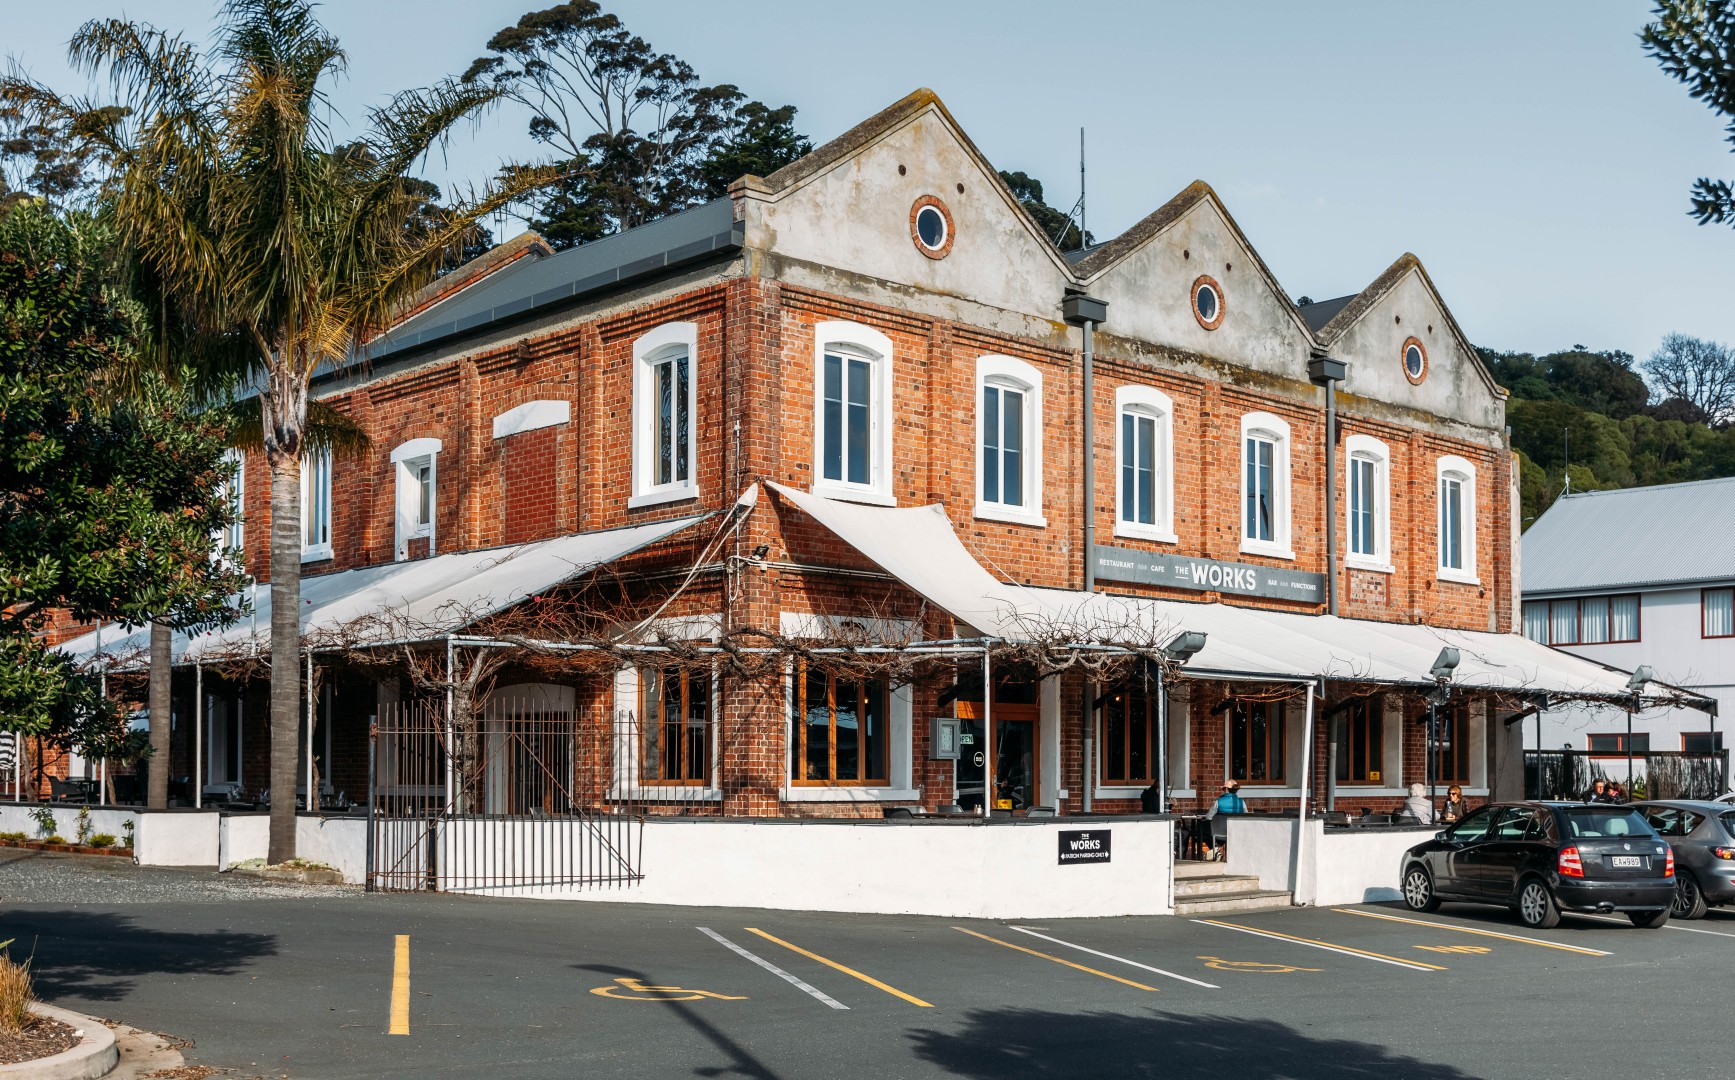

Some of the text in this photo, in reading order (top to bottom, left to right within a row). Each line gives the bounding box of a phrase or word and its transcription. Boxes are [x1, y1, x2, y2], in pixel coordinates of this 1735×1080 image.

[1099, 558, 1165, 573] RESTAURANT CAFE
[1174, 562, 1257, 591] THE WORKS
[1290, 581, 1317, 591] FUNCTIONS
[1070, 840, 1101, 850] WORKS
